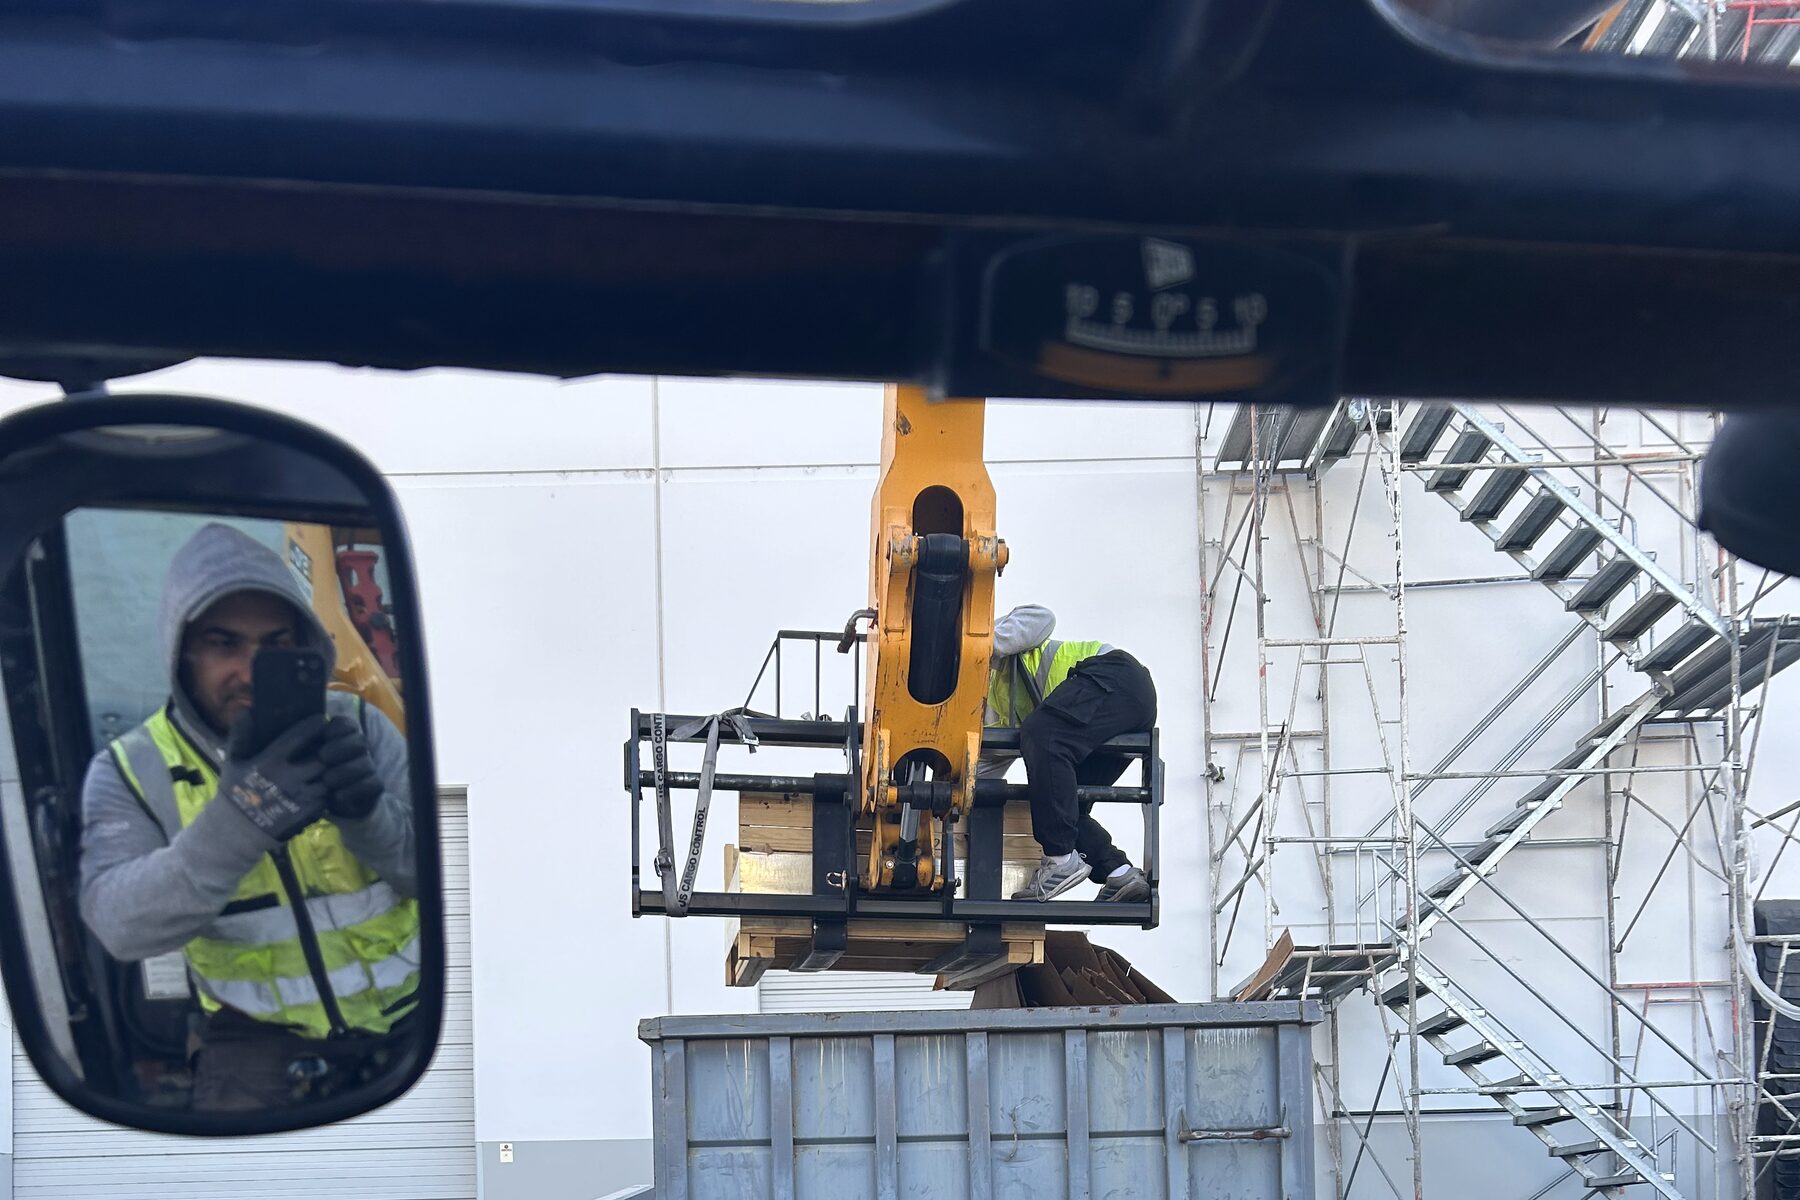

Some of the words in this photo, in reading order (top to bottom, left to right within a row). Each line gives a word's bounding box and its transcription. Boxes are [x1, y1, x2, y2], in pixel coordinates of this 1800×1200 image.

[656, 746, 664, 781] CARGO
[692, 807, 706, 855] CONTROL
[682, 858, 697, 891] CARGO
[679, 894, 688, 907] US
